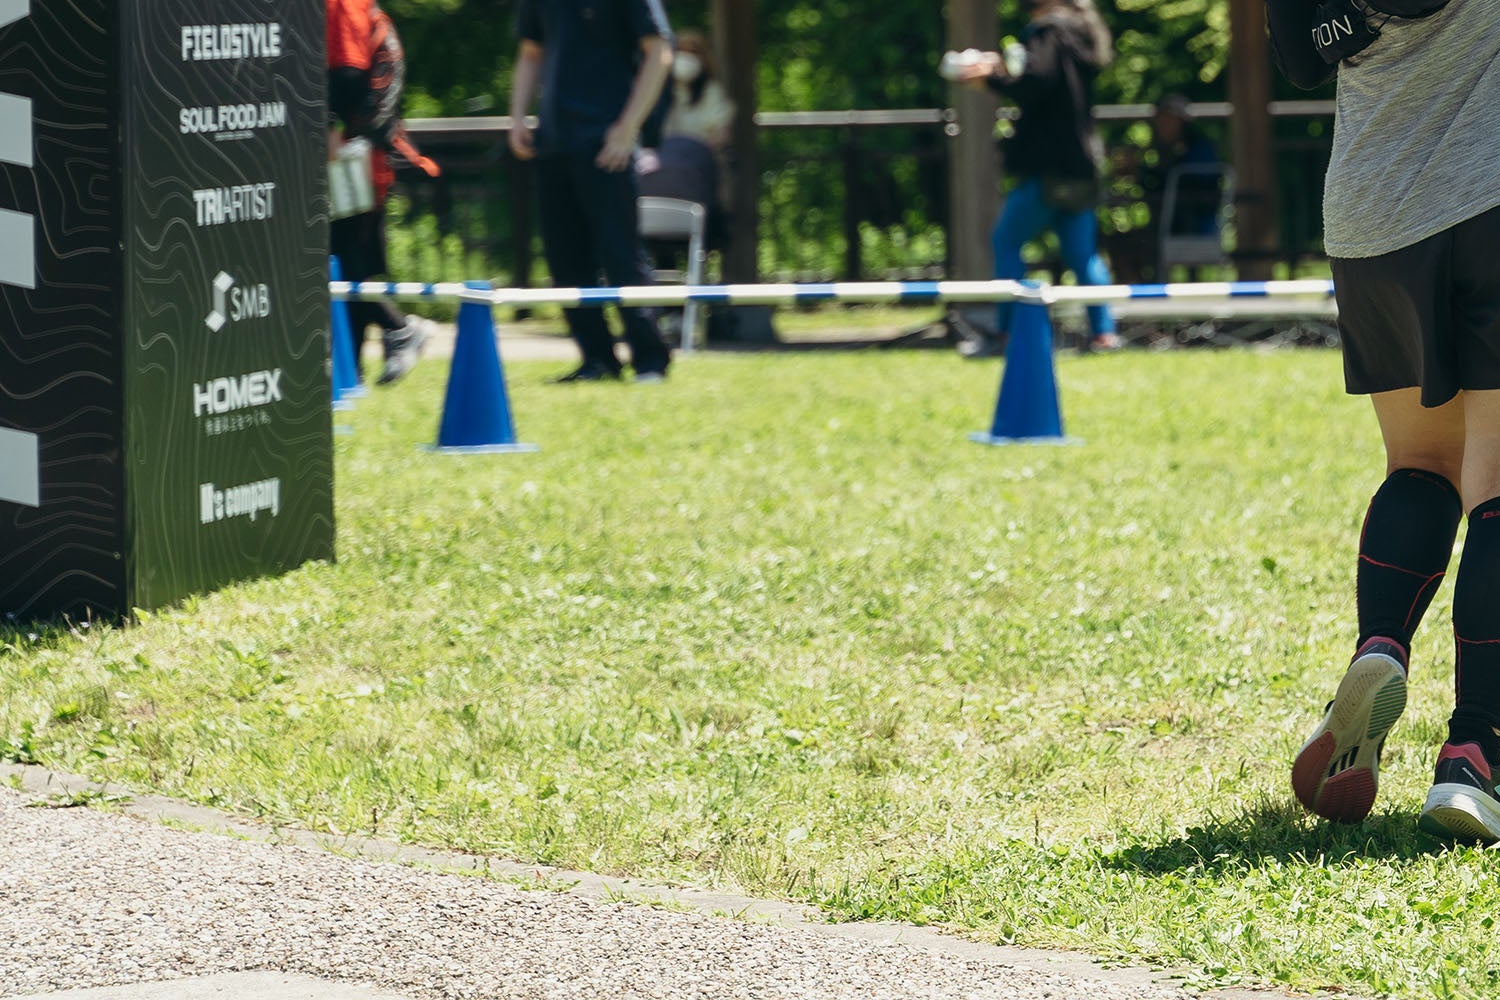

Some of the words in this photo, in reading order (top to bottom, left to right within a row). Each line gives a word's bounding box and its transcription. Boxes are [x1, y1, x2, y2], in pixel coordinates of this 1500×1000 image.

[181, 22, 281, 61] FIELDSTYLE
[180, 106, 218, 134] SOUL
[218, 104, 257, 131] FOOD
[257, 101, 285, 128] JAM
[230, 283, 270, 321] SMB
[193, 368, 282, 417] HOMEX
